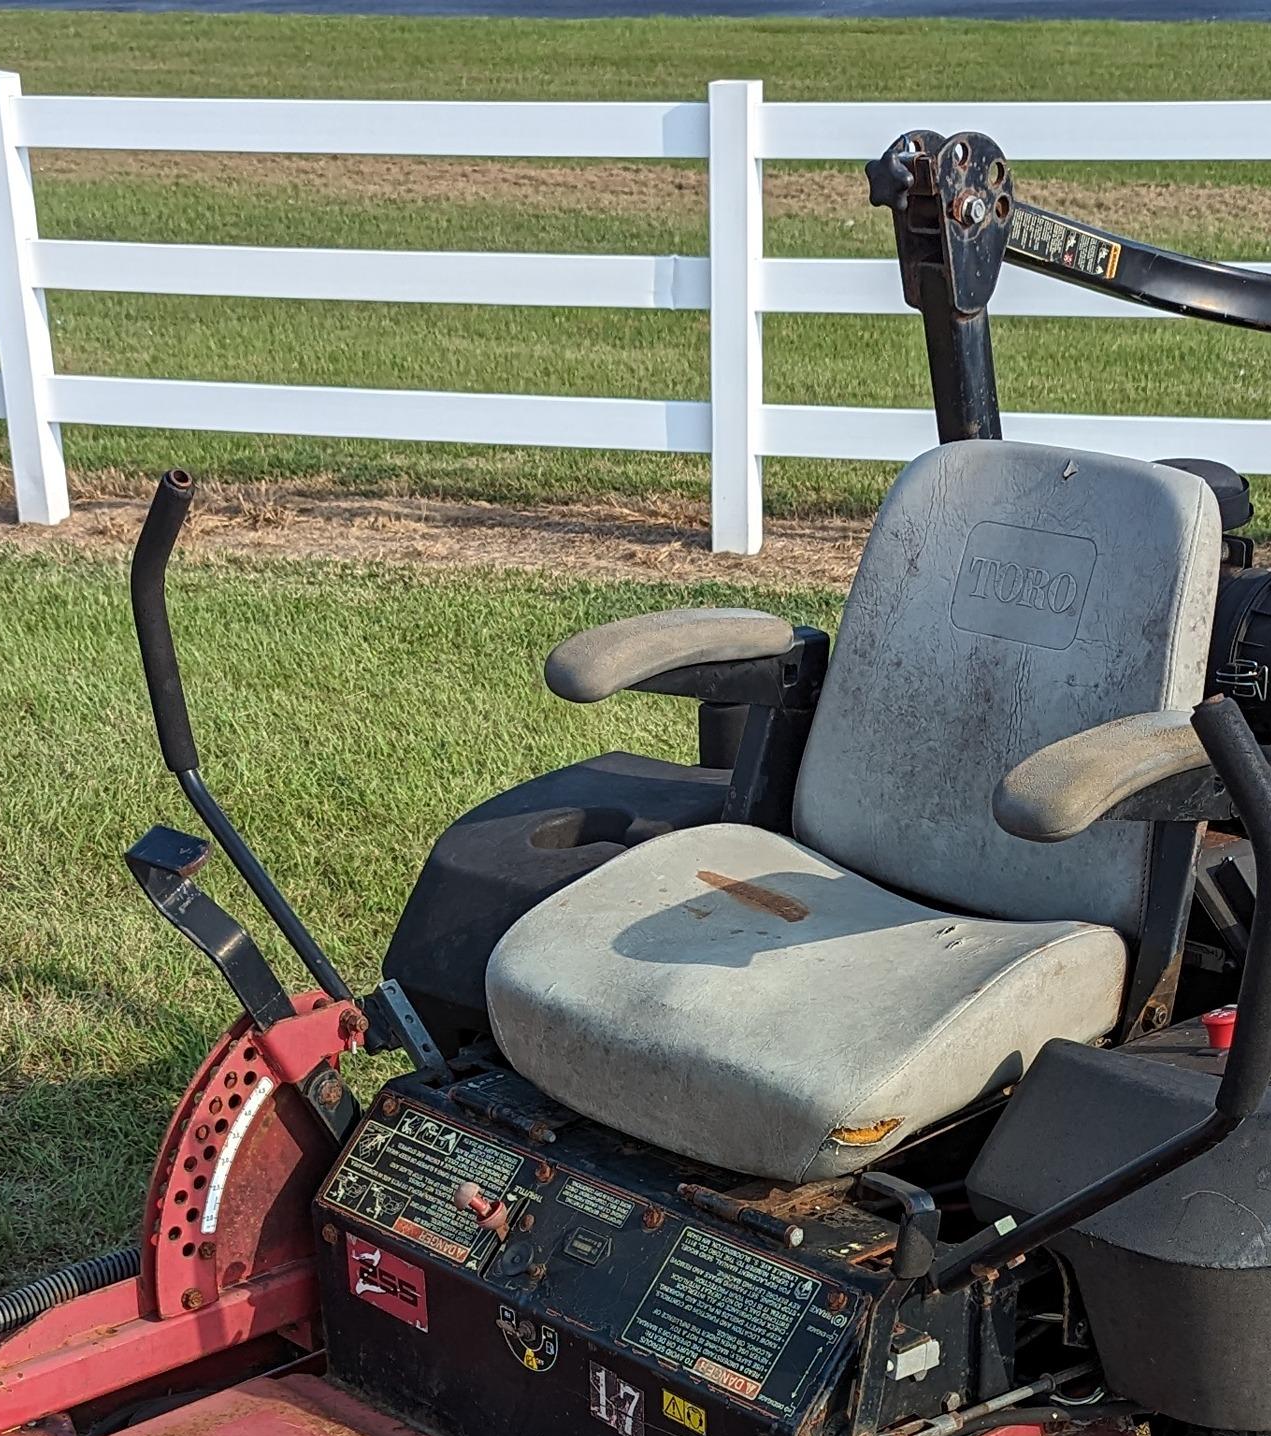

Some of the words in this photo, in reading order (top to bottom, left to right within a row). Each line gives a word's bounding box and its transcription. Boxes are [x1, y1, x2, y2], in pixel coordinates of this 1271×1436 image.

[969, 556, 1079, 615] TORO
[415, 1230, 458, 1255] DANGER
[807, 1302, 834, 1321] BRAKE
[696, 1360, 745, 1390] DANGER
[594, 1367, 642, 1436] 17
